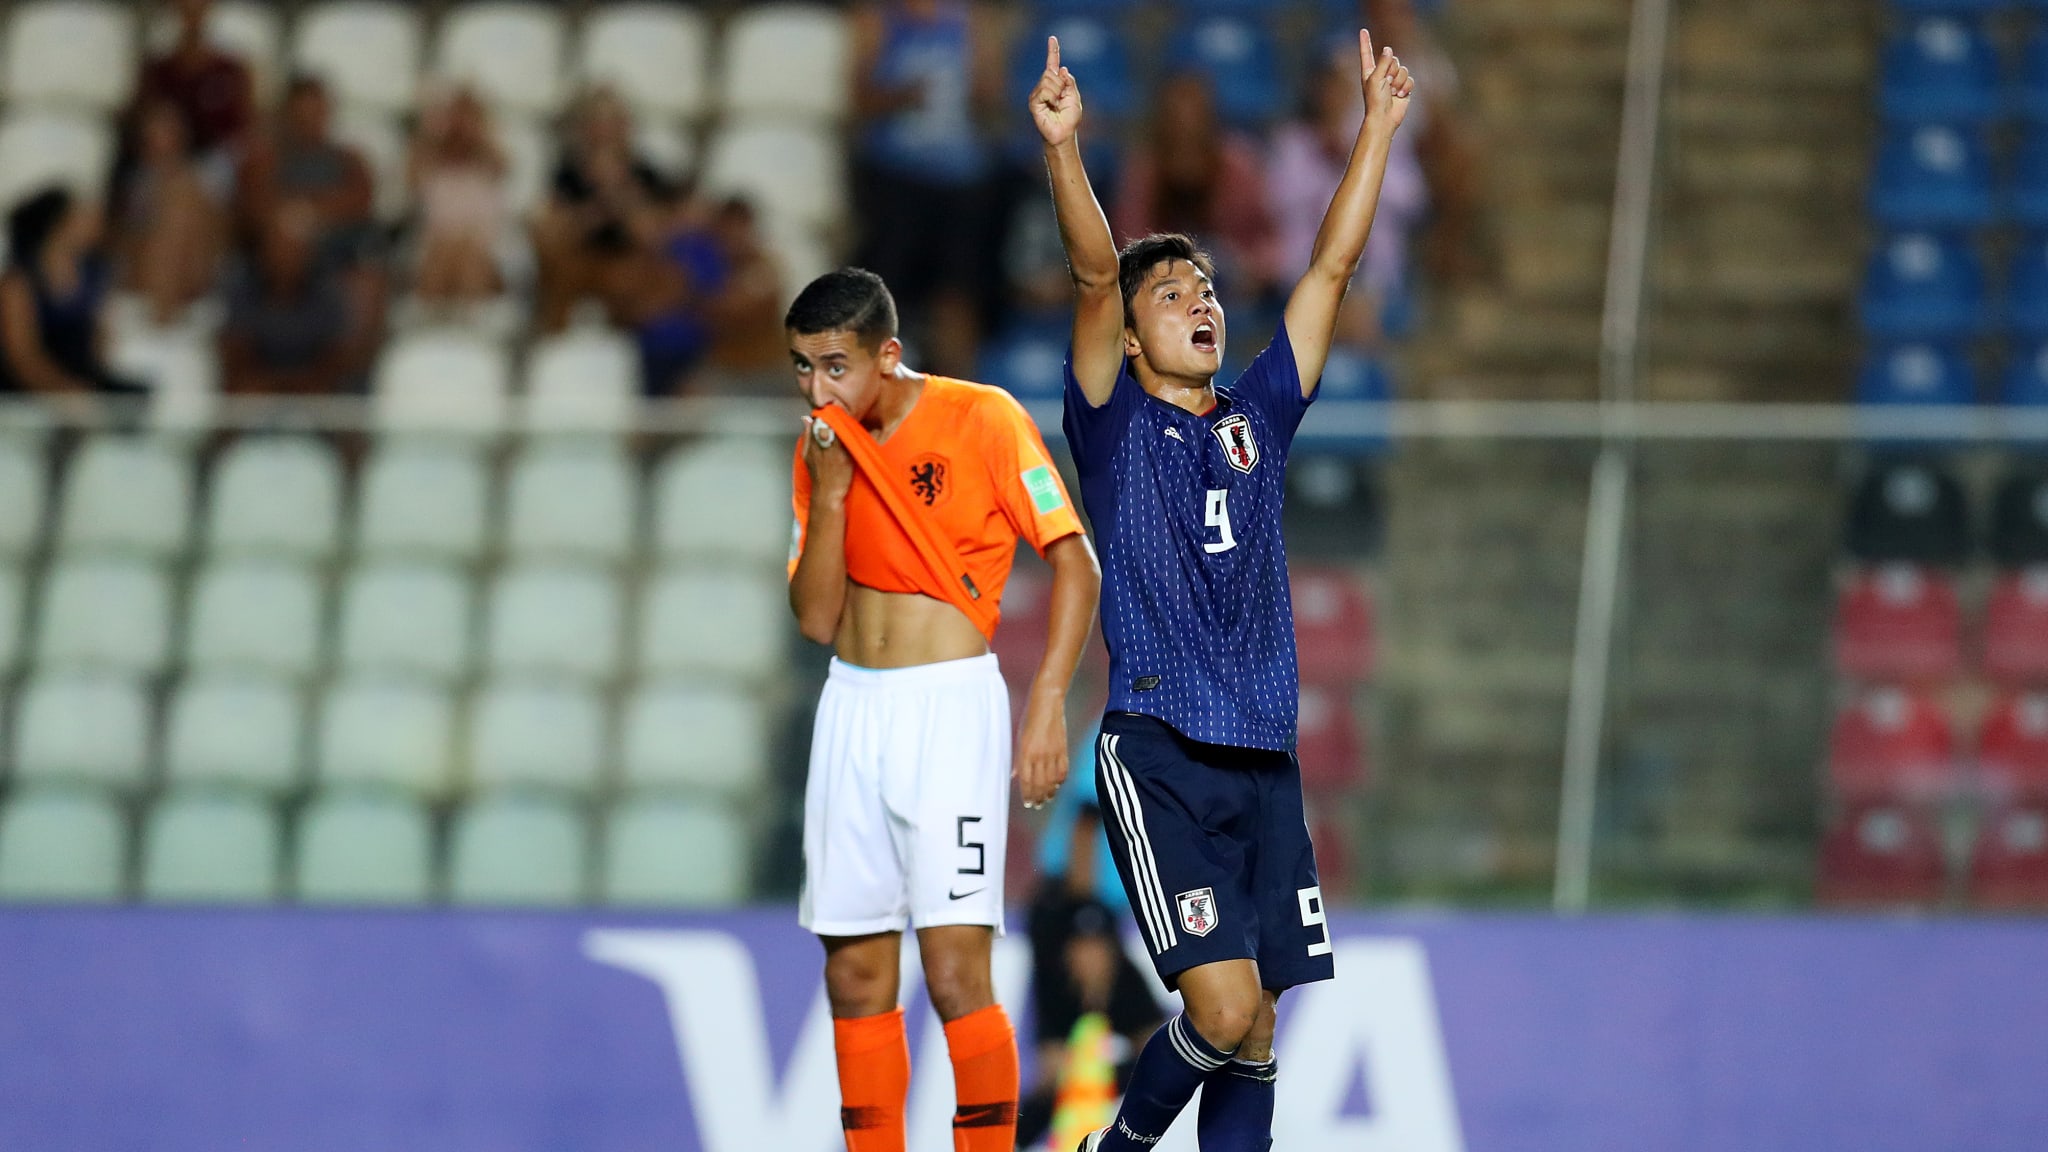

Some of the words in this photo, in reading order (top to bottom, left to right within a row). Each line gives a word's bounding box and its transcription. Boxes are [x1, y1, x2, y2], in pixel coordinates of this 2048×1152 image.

[1203, 489, 1237, 554] 9
[957, 816, 985, 875] 5
[1297, 886, 1333, 957] 9
[581, 929, 1465, 1152] VA
